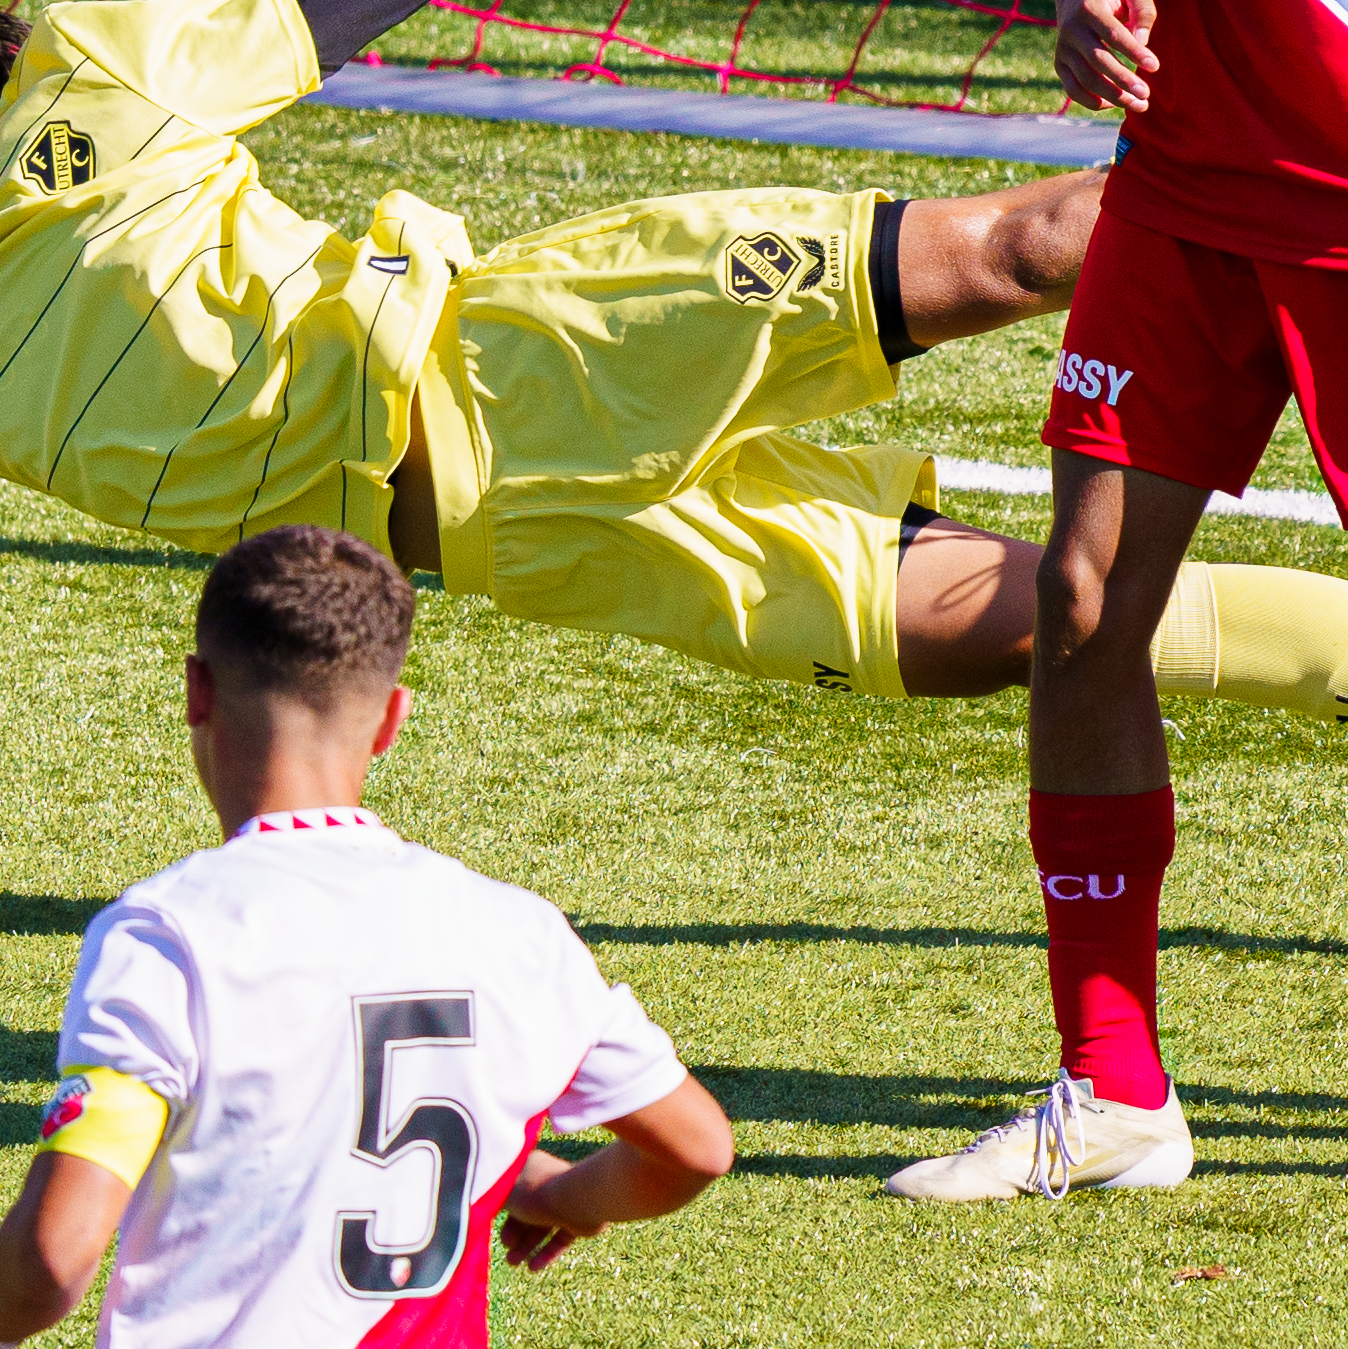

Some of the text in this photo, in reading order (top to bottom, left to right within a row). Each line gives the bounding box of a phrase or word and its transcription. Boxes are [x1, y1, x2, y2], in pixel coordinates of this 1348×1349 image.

[31, 151, 48, 170] F
[52, 127, 71, 191] UTRECHT
[71, 148, 89, 167] C
[733, 243, 785, 288] UTRECHT
[763, 246, 782, 261] C
[830, 235, 839, 287] CASTORE
[734, 274, 754, 287] F
[1038, 867, 1126, 901] CU
[333, 990, 478, 1300] 5
